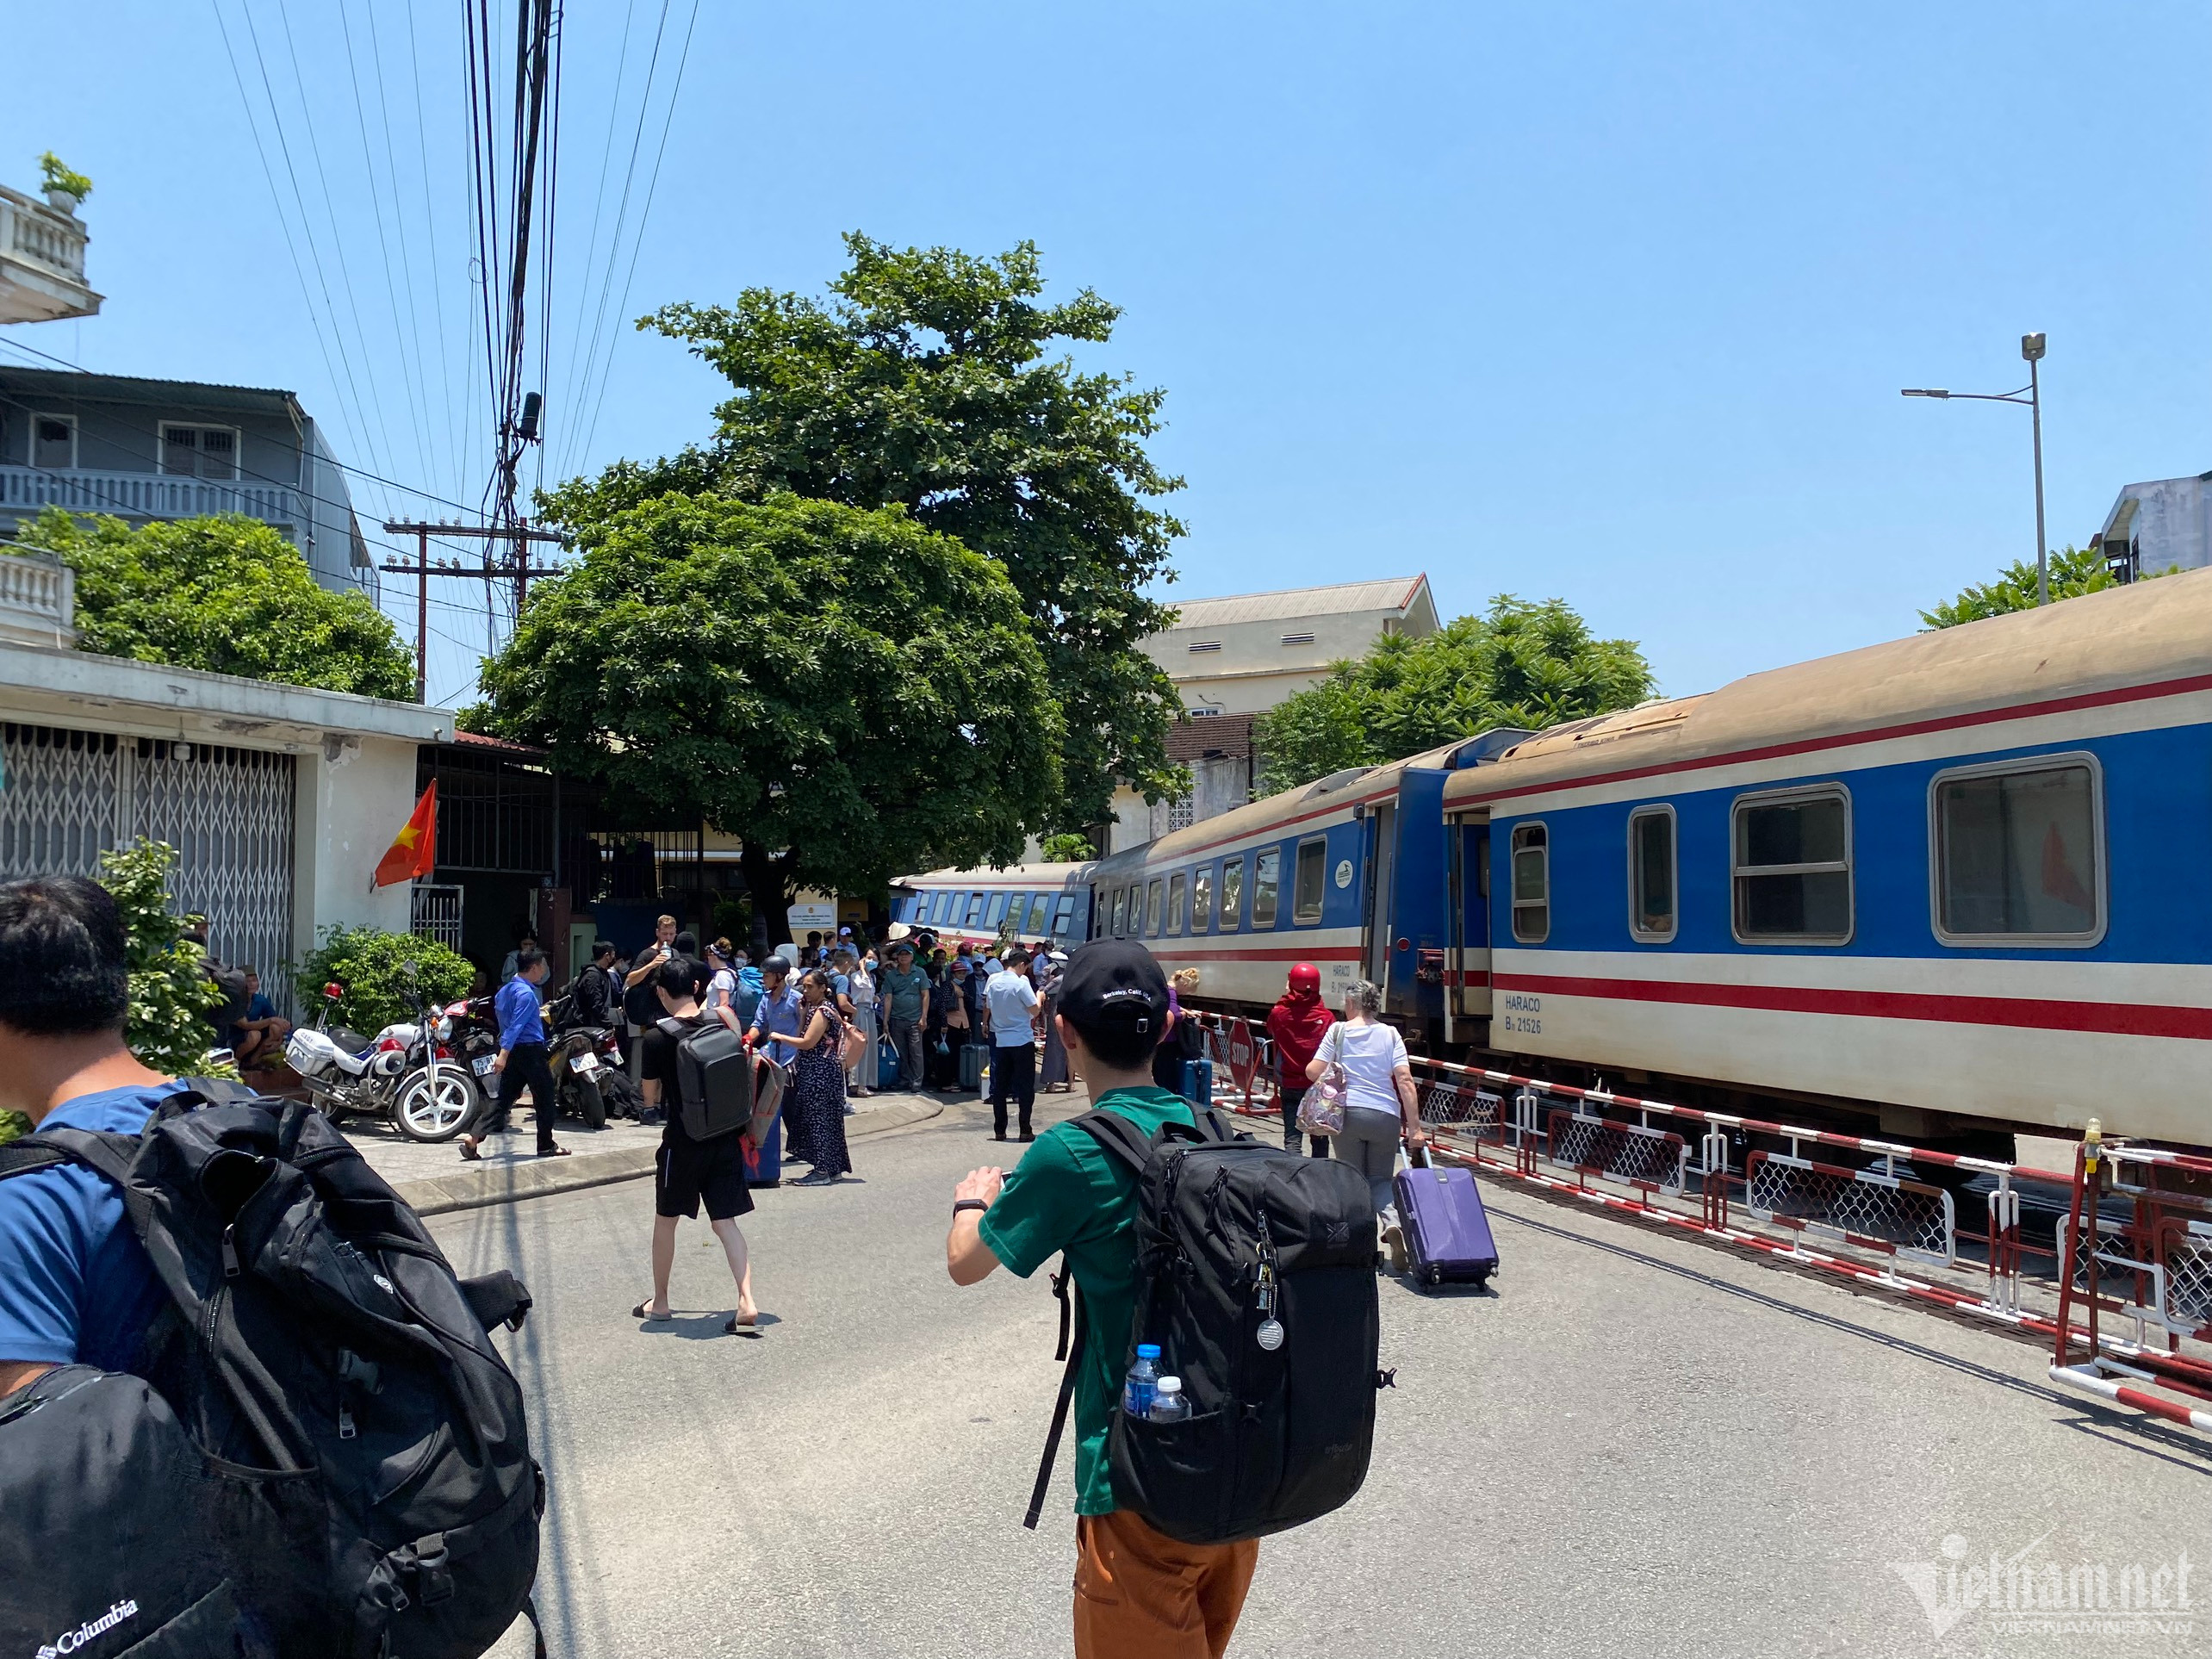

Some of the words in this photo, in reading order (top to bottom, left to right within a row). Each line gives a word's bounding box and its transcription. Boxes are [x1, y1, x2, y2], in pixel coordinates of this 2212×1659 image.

[1505, 995, 1540, 1013] HARACO
[1517, 1017, 1541, 1034] 21526
[1232, 1041, 1249, 1067] STOP
[57, 1600, 139, 1655] Columbia
